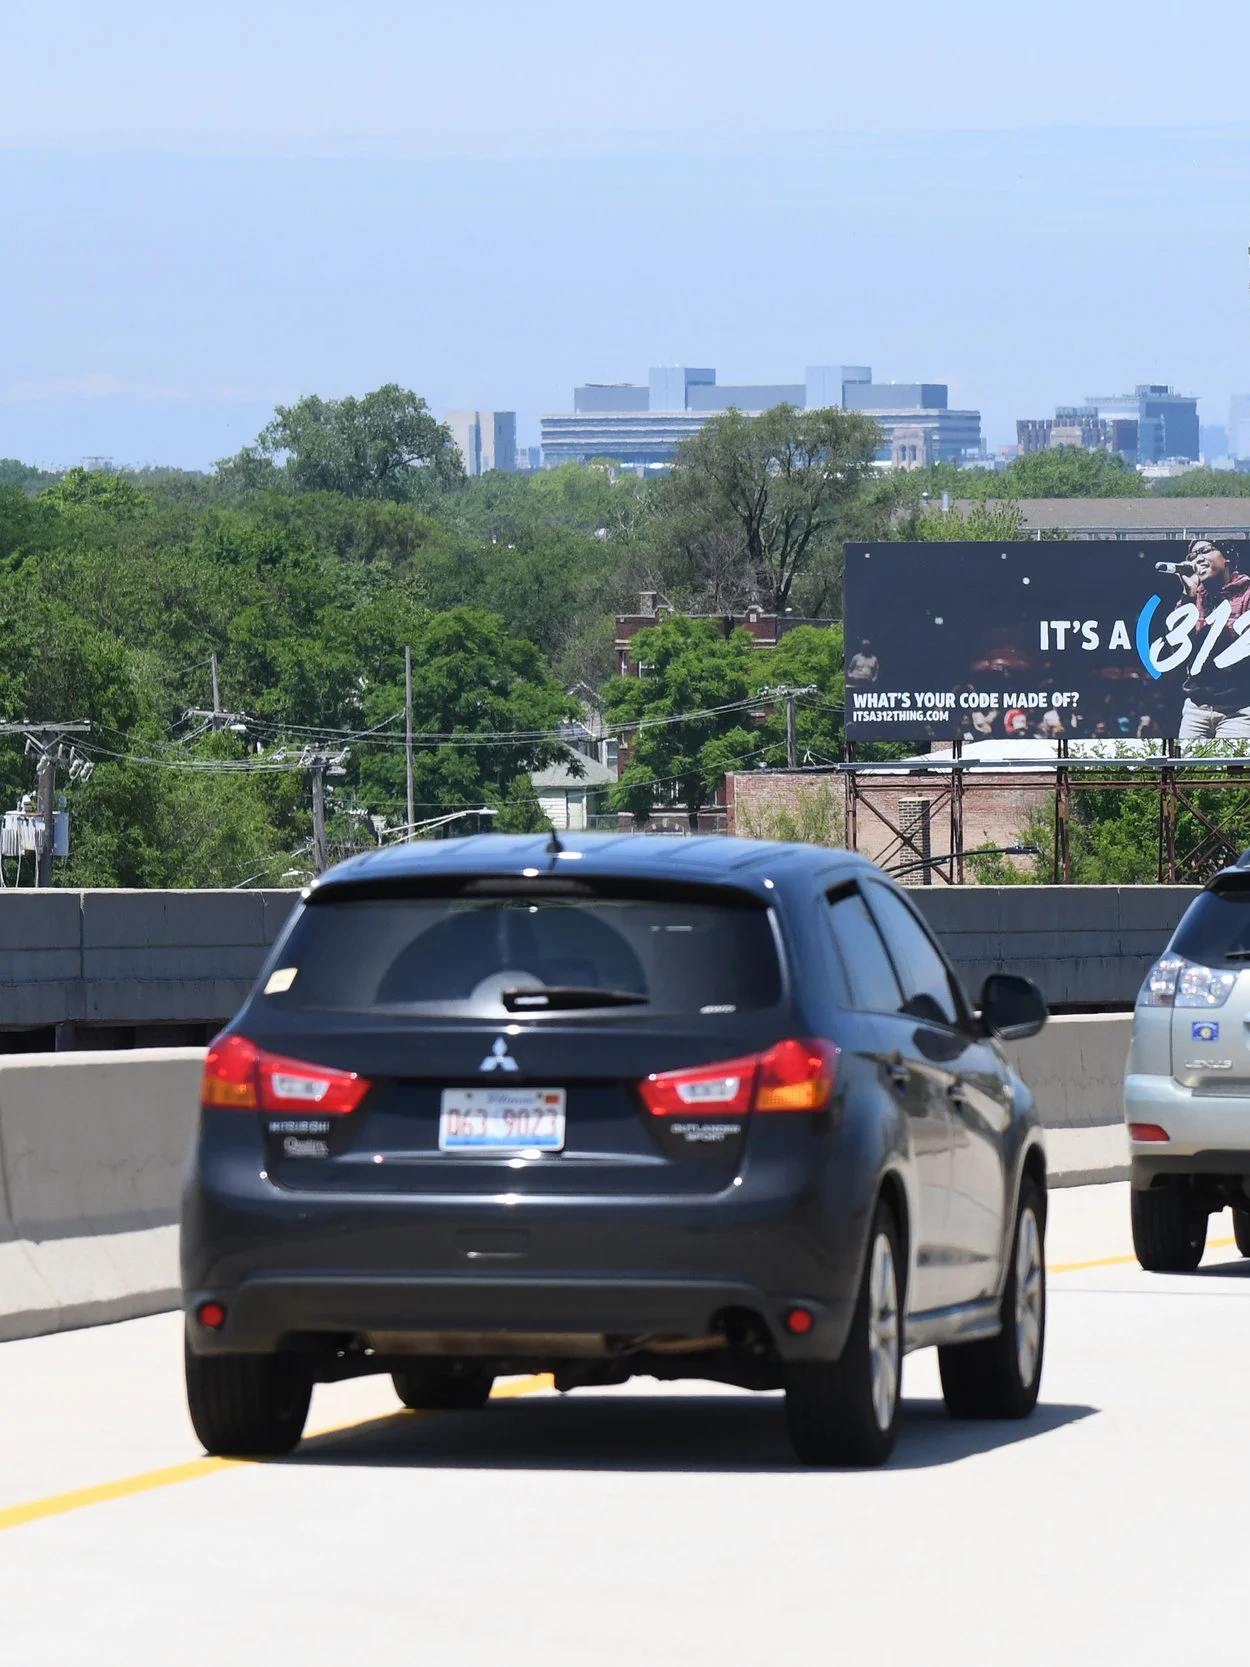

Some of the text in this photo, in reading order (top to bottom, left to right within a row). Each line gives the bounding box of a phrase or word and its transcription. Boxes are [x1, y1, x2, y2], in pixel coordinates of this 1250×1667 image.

[1040, 620, 1100, 651] IT'S
[1108, 619, 1132, 650] A
[853, 691, 1080, 709] WHAT'S YOUR CODE MADE OF?
[853, 710, 949, 722] ITSA312THING.COM
[503, 1107, 558, 1138] 9023
